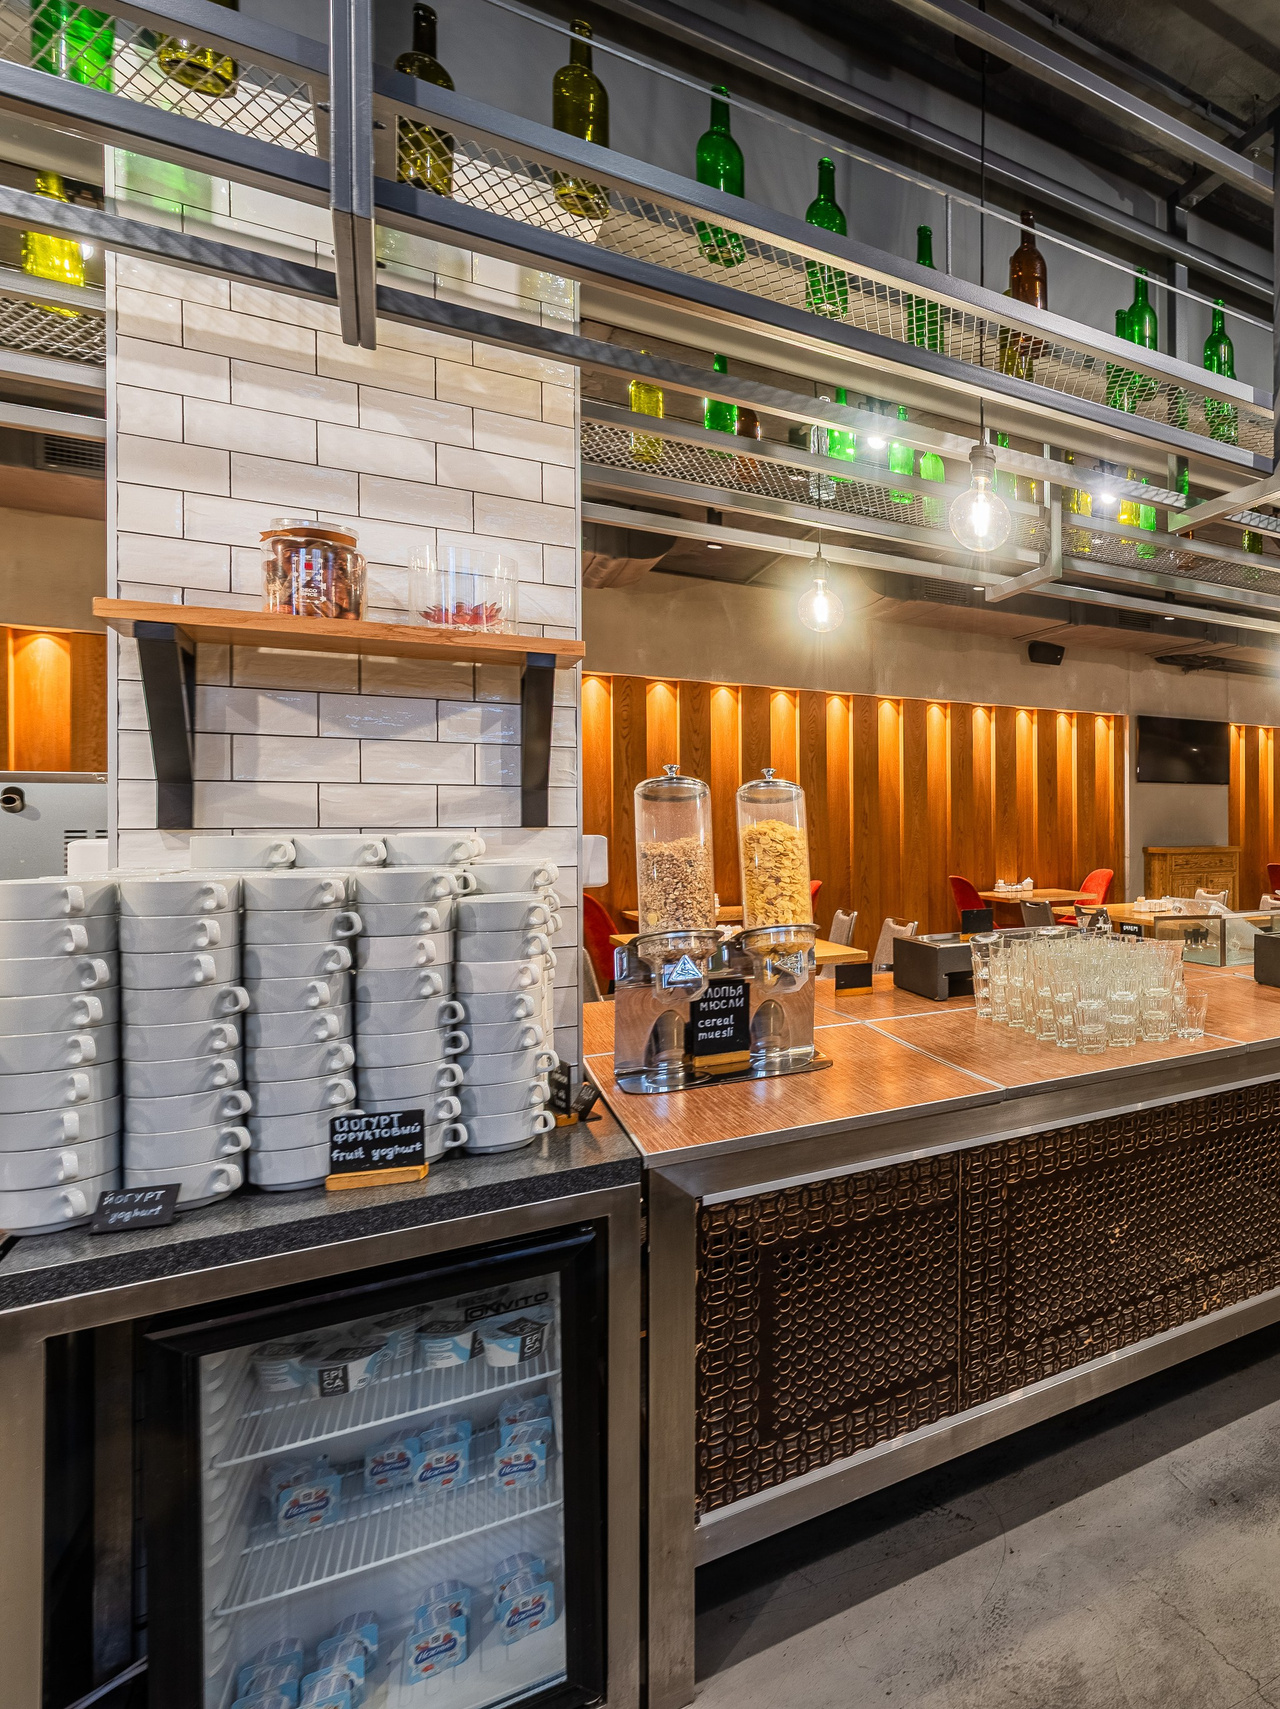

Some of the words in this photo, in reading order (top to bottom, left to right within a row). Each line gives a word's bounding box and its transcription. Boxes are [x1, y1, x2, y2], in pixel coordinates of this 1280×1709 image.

[700, 997, 745, 1011] МЮСЛИ
[697, 1014, 735, 1028] cereal
[697, 1026, 734, 1041] muesli
[334, 1113, 403, 1132] ЙОГУРТ
[331, 1146, 365, 1161] fruit
[371, 1142, 422, 1161] yoghurt
[108, 1204, 163, 1225] yoghurt
